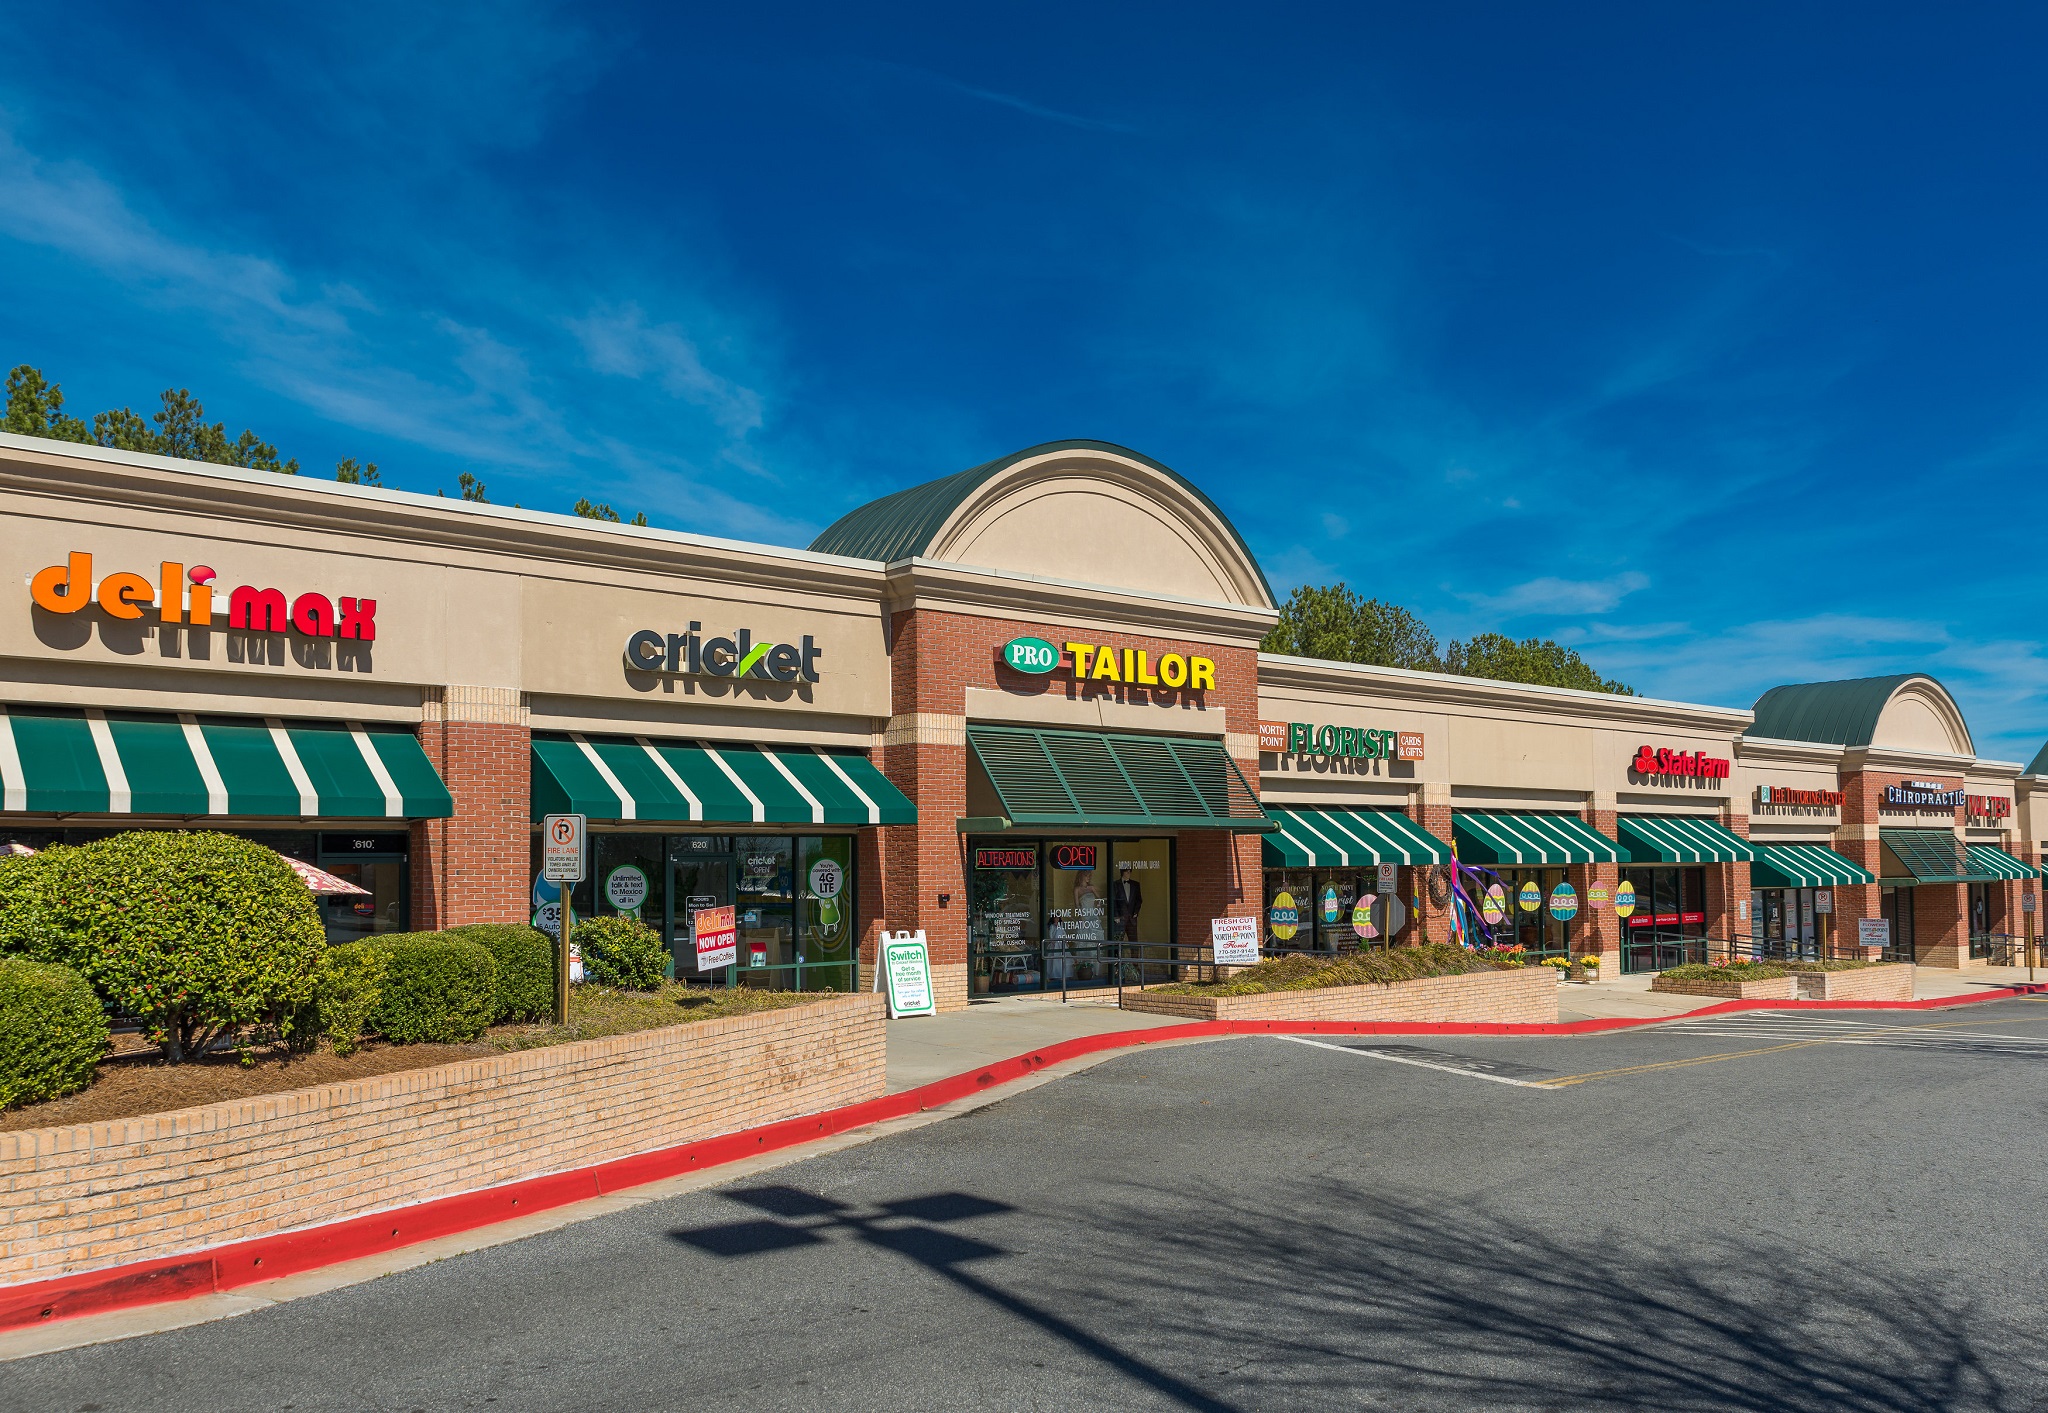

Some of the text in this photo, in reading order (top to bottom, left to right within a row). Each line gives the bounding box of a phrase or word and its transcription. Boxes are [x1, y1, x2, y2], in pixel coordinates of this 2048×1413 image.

[31, 551, 376, 641] deli max
[626, 621, 822, 683] cricket
[1012, 642, 1216, 690] PRO TAILOR
[1259, 724, 1286, 736] NORTH
[1260, 736, 1284, 747] POINT
[1289, 722, 1394, 760] FLORIST
[1400, 735, 1422, 746] CARDS
[1400, 748, 1423, 757] & GIFTS
[1659, 748, 1730, 778] State Farm
[1770, 786, 1785, 804] THE
[1821, 789, 1847, 806] CENTER
[1888, 785, 1964, 806] CHIROPRACTIC
[355, 840, 372, 848] 610
[748, 856, 775, 864] cricket
[978, 852, 1034, 866] ALTERATIONS
[1058, 846, 1094, 866] OPEN
[819, 873, 834, 883] 4G
[820, 883, 834, 893] LTE
[1050, 907, 1104, 917] HOME FASHION
[1056, 920, 1100, 930] ALTERATIONS
[699, 932, 734, 950] NOW OPEN
[891, 950, 922, 960] Switch
